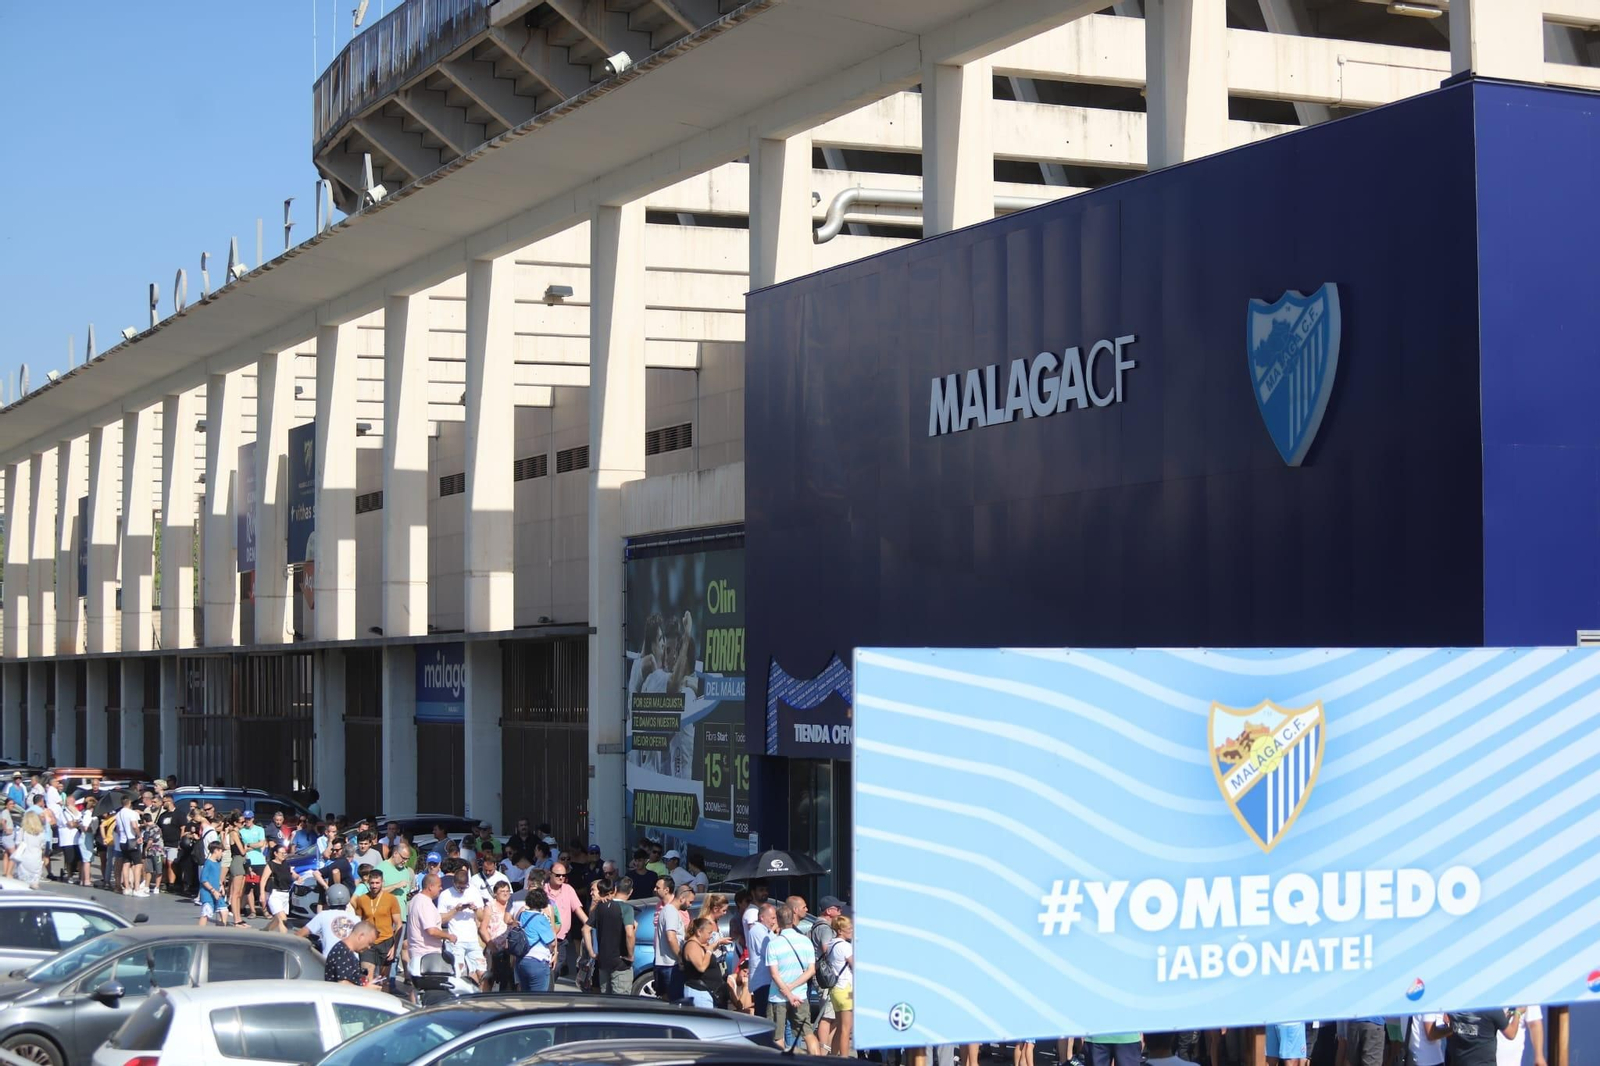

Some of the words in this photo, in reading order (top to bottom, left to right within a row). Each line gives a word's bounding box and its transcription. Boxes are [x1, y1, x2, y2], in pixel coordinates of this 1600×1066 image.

[706, 681, 719, 696] DEL
[794, 724, 830, 744] TIENDA
[705, 752, 721, 788] 15
[735, 754, 749, 790] 19
[1231, 739, 1283, 789] MALAGA
[645, 793, 659, 823] POR
[660, 794, 693, 827] USTEDES!
[1038, 866, 1481, 936] #YOMEQUEDO
